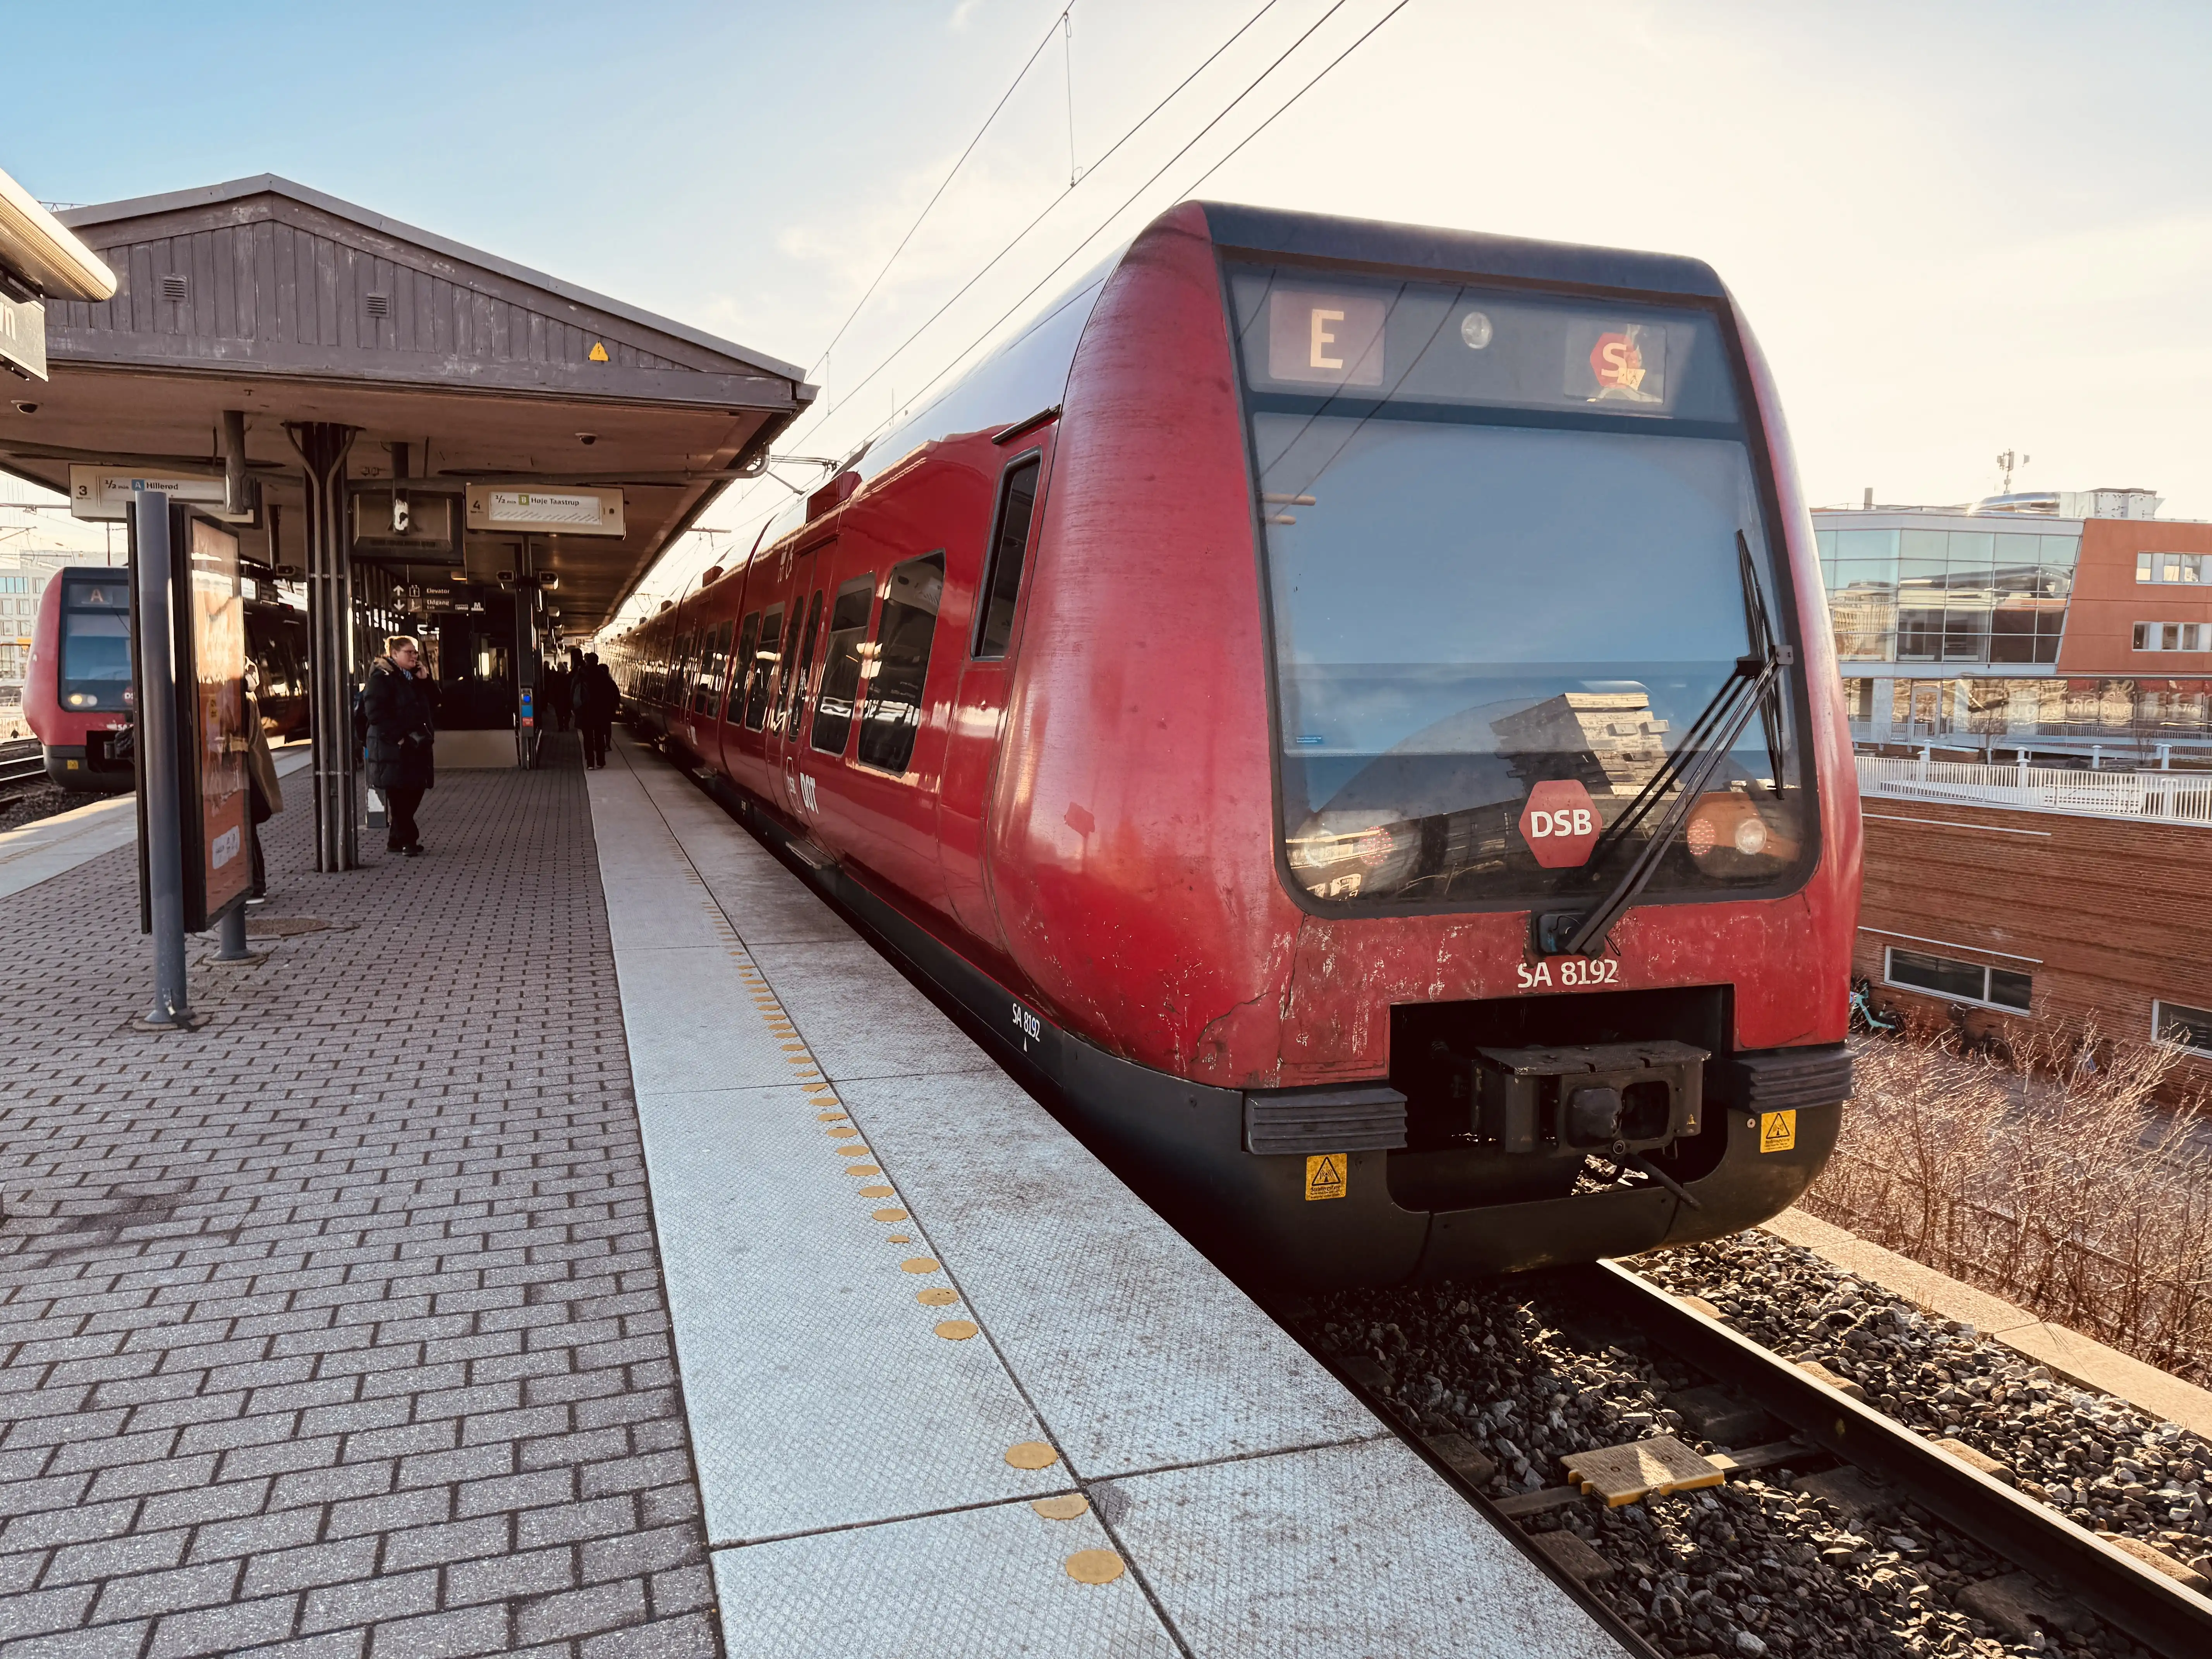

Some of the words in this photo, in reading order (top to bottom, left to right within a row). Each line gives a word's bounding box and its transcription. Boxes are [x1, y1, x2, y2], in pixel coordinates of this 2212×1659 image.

[1310, 309, 1344, 369] E
[1601, 342, 1627, 377] S
[79, 486, 88, 496] 3
[473, 500, 481, 510] 4
[549, 498, 580, 507] Taastrup
[91, 589, 103, 602] A
[1530, 809, 1592, 837] DSB
[1518, 962, 1553, 988] SA
[1561, 959, 1619, 986] 8192
[1013, 1003, 1022, 1028] SA
[1024, 1011, 1040, 1042] 8192
